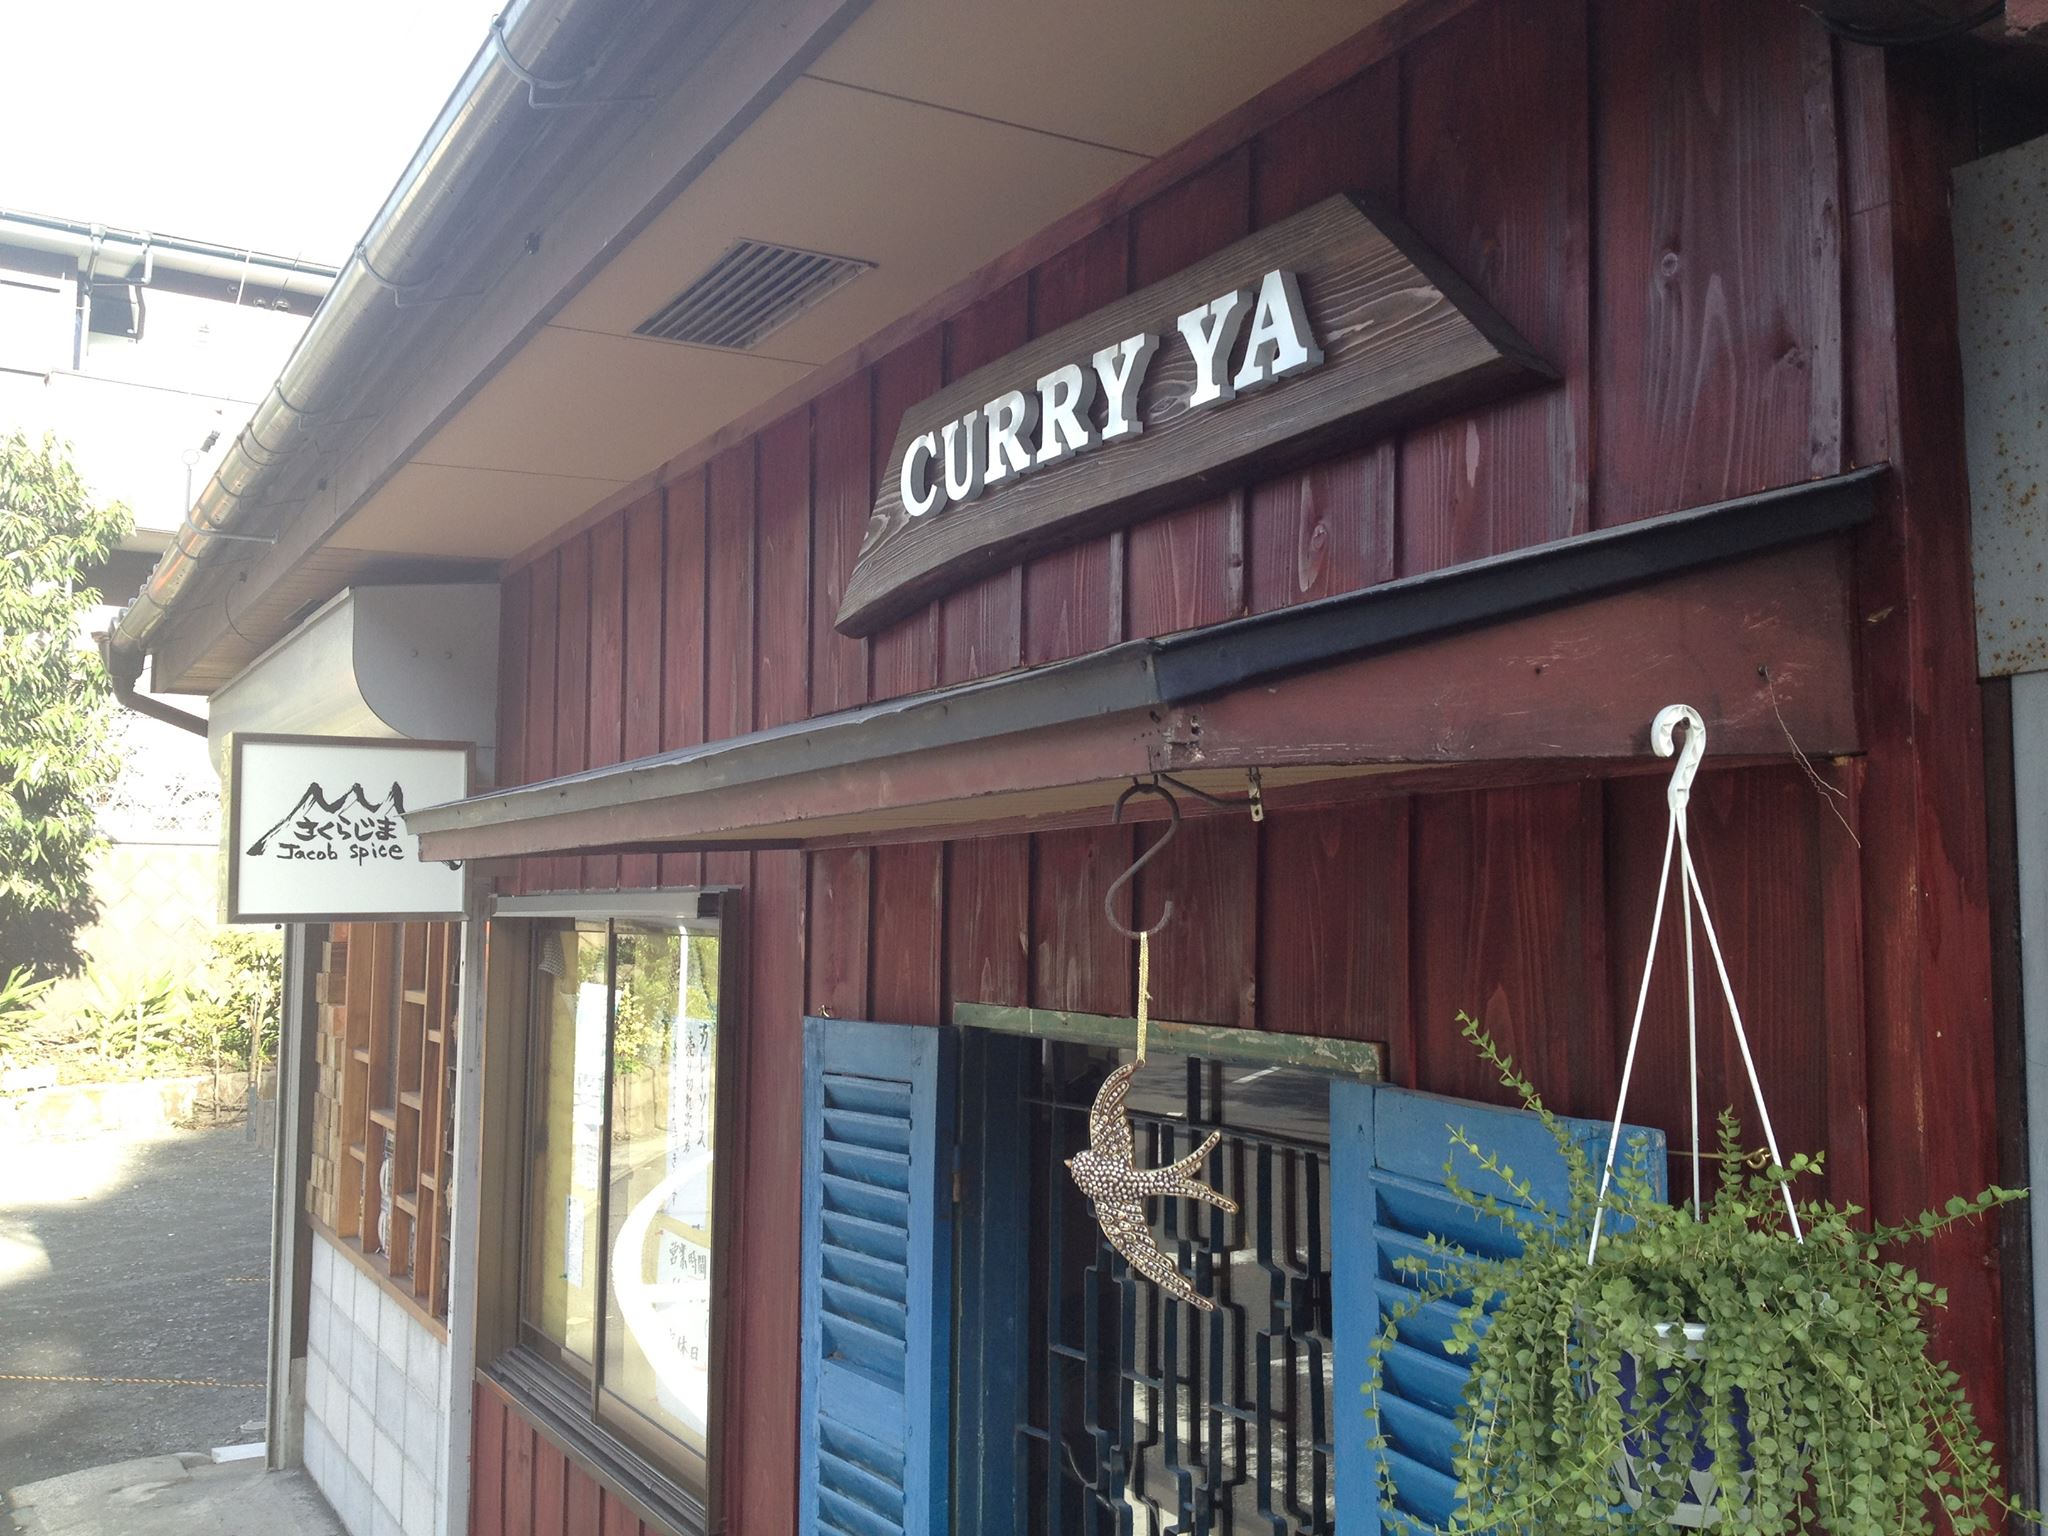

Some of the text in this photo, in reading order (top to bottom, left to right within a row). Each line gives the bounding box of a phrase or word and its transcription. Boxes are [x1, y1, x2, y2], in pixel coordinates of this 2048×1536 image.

[901, 269, 1325, 518] CURRY YA
[293, 815, 397, 841] さくらじま
[276, 842, 338, 860] Jacob
